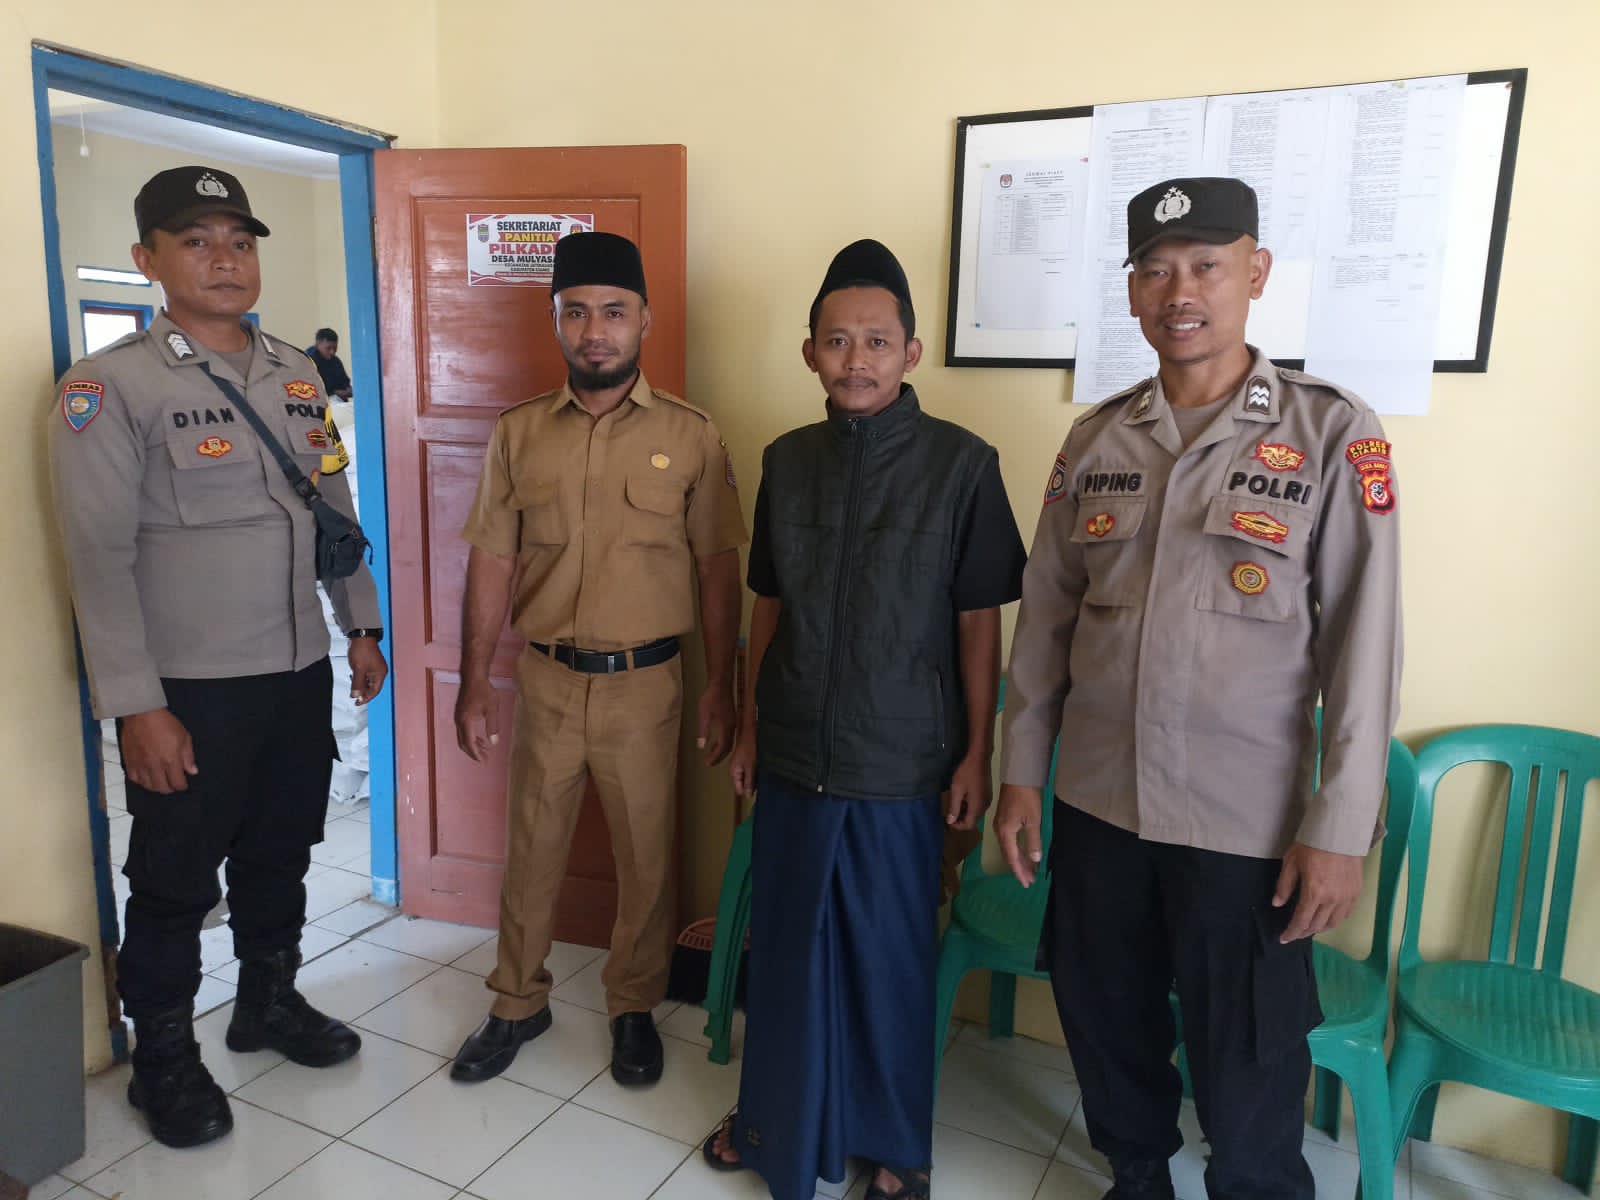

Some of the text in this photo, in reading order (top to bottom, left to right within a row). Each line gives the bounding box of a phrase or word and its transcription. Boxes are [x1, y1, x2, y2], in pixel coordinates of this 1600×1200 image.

[496, 221, 562, 232] SEKRETARIAT
[504, 232, 555, 242] PANITIA
[491, 255, 555, 263] DESA MULYAS
[173, 407, 235, 428] DIAN
[1084, 472, 1142, 493] PIPING
[1228, 471, 1312, 505] POLRI
